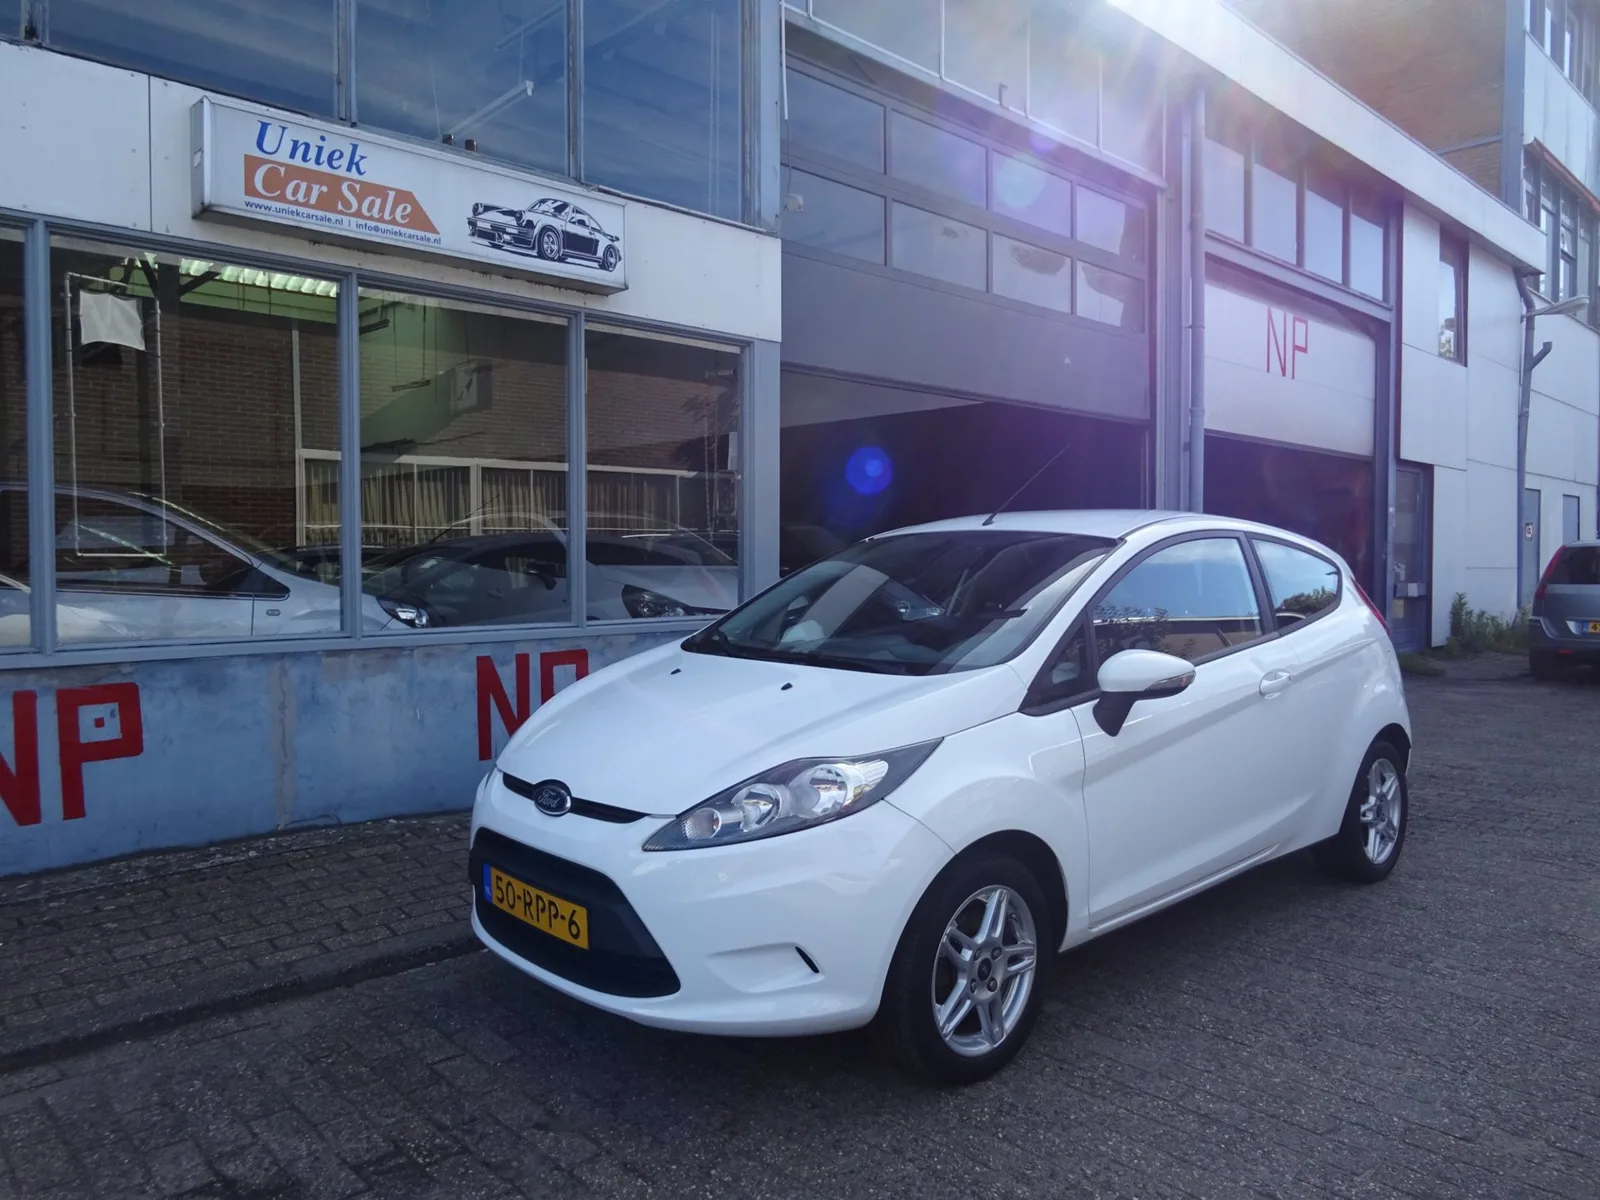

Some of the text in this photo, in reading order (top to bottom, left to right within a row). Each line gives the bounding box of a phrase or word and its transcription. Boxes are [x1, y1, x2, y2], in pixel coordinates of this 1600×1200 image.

[256, 119, 368, 176] Uniek
[244, 200, 344, 226] www.uniekcarsale.nl
[355, 220, 442, 245] info@uniekcarsale.nl
[253, 163, 412, 223] Car Sale
[1266, 305, 1309, 380] NP
[495, 875, 581, 940] 50-RPP-6
